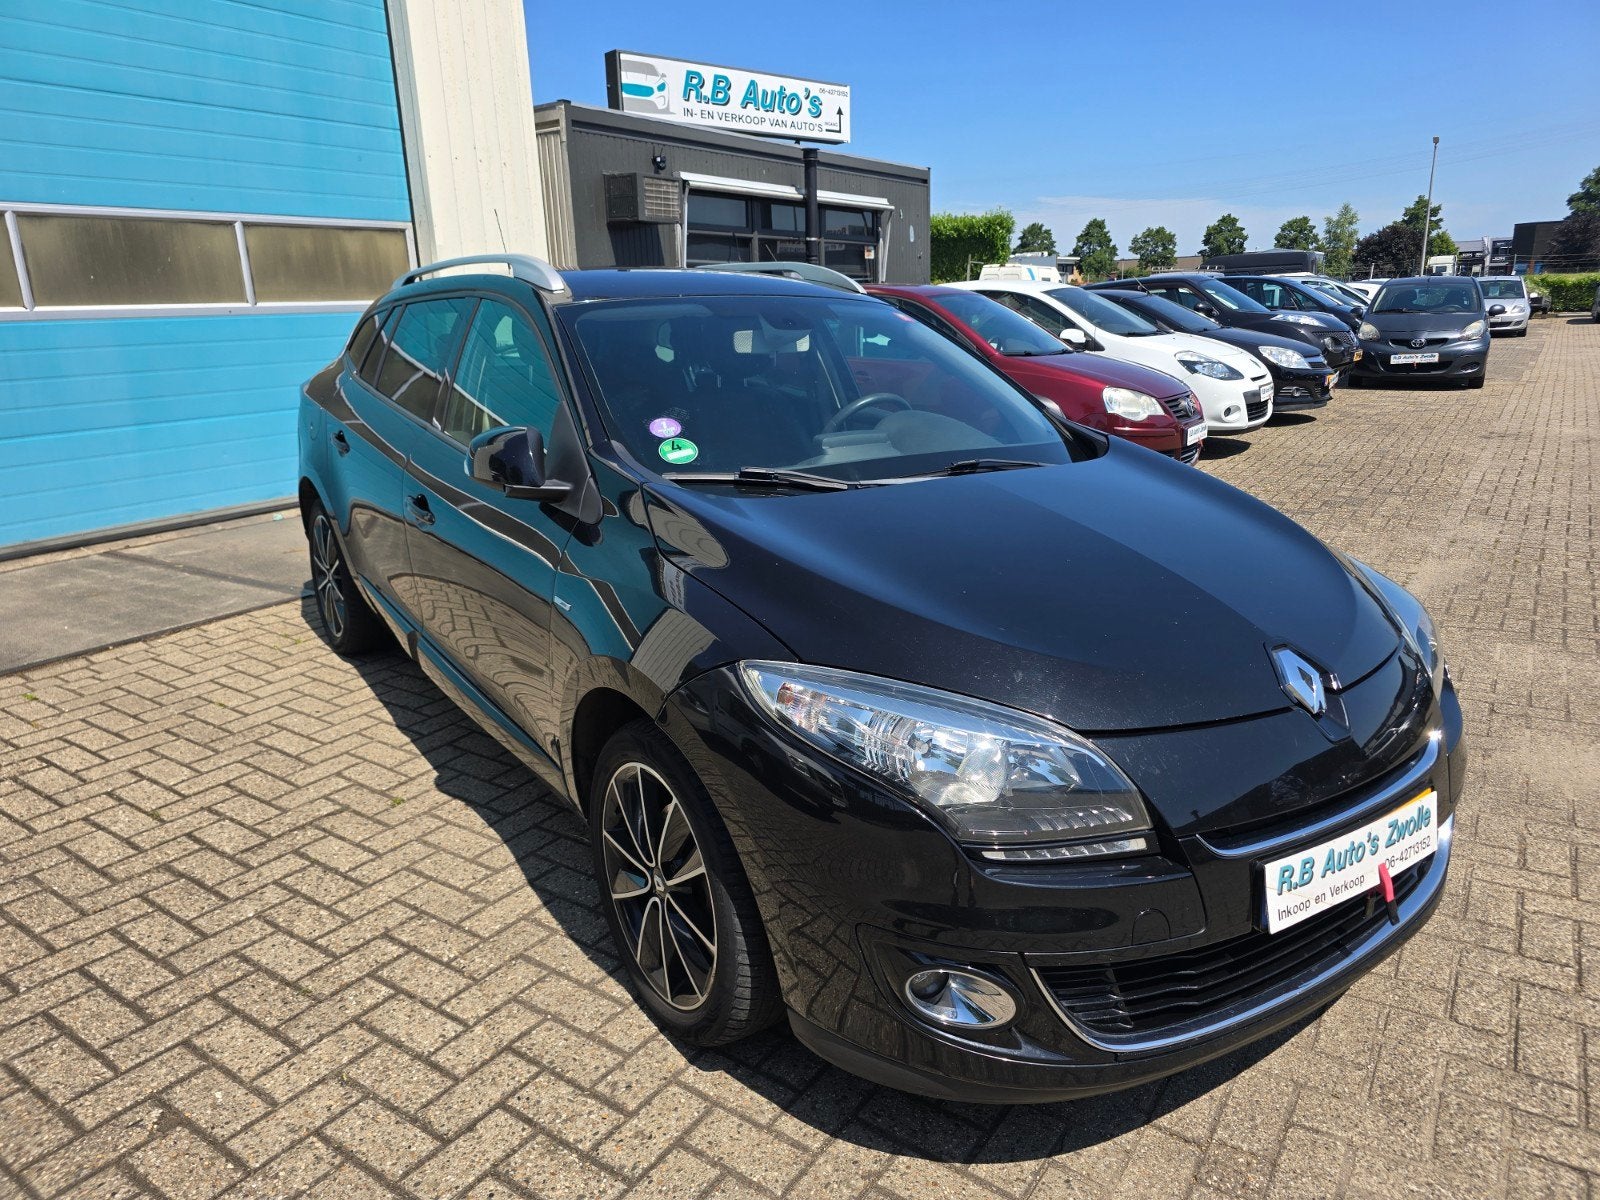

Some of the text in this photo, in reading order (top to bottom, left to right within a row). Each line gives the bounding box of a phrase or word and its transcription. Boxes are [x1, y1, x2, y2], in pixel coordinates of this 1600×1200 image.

[683, 70, 822, 118] R.B Auto's
[683, 108, 823, 132] IN- EN VERKOOP VAN AUTO'S
[672, 441, 682, 450] 4
[1277, 805, 1431, 895] R.B Auto's Zwolle
[1278, 836, 1431, 921] Inkoop en Verkoop 06-42713152
